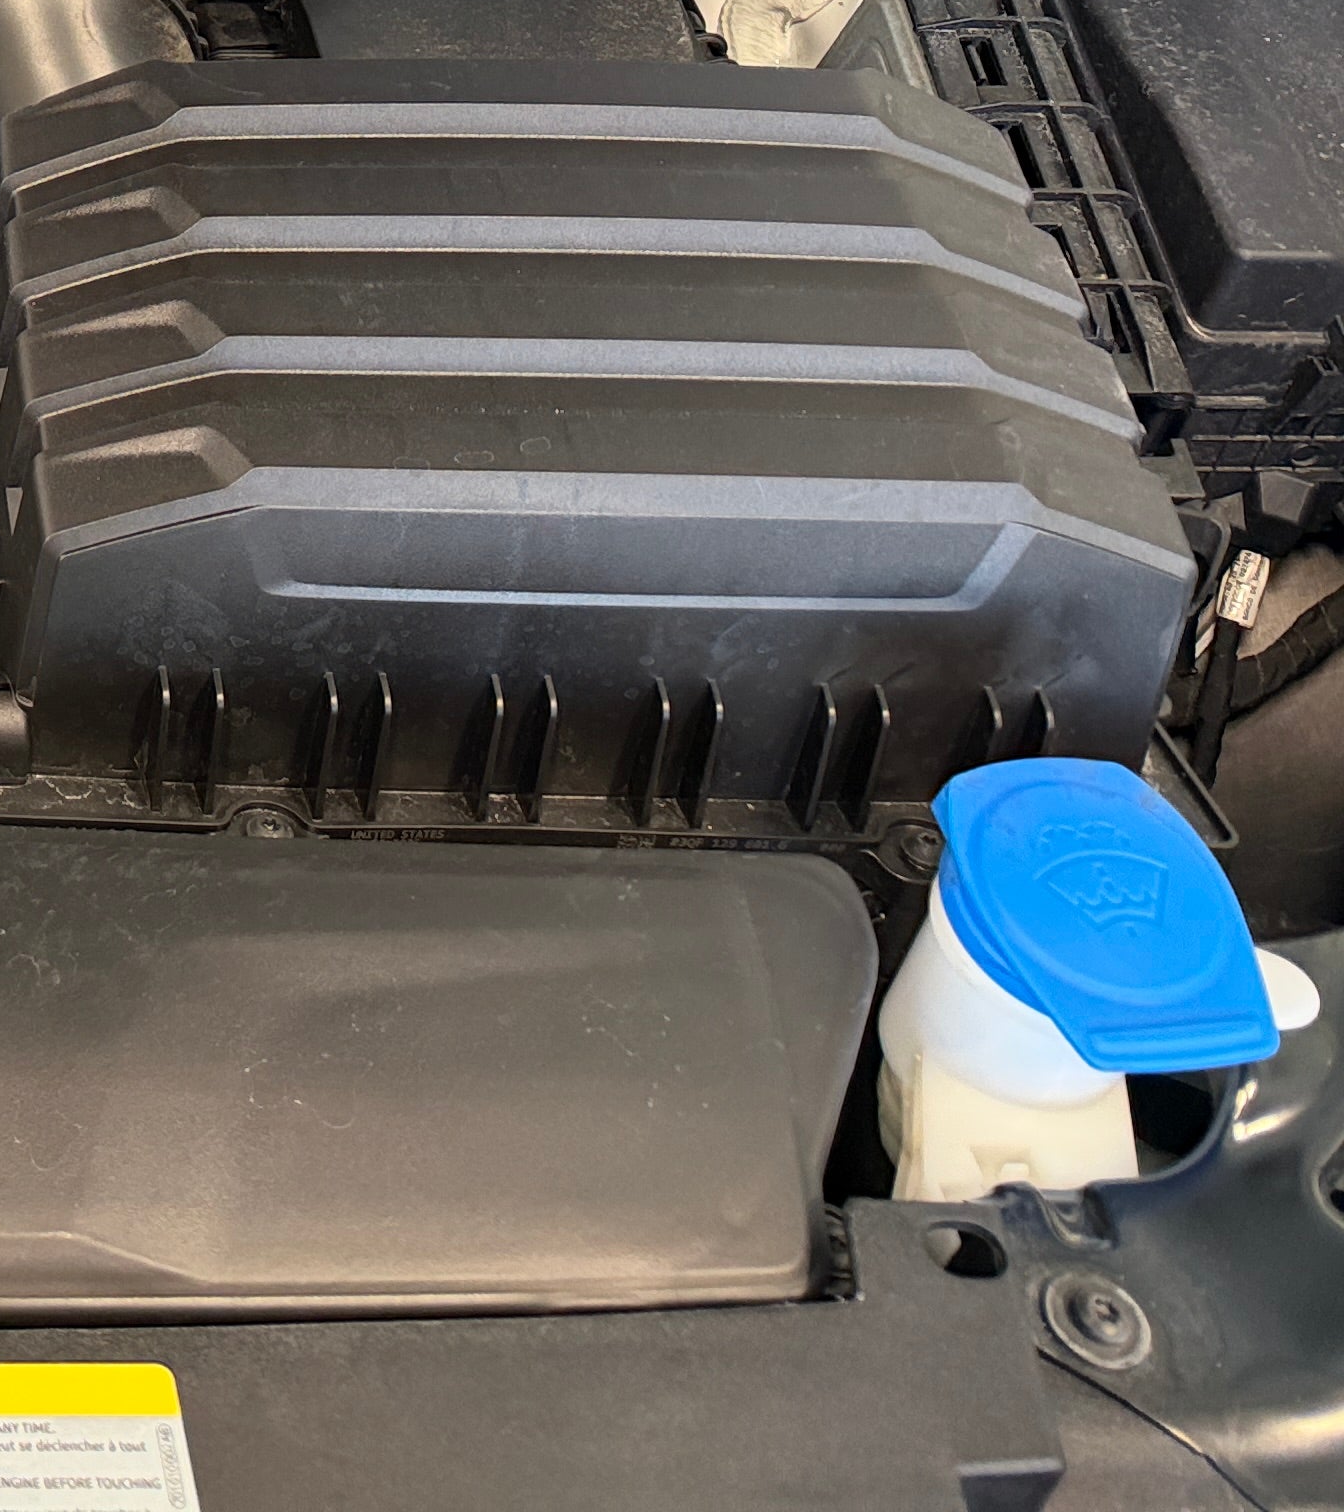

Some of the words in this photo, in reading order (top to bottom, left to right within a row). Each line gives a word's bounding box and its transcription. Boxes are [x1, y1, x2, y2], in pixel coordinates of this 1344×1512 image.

[18, 1441, 33, 1453] se
[120, 1440, 148, 1453] tout
[43, 1476, 94, 1490] BEFORE
[95, 1476, 163, 1490] TOUCHING
